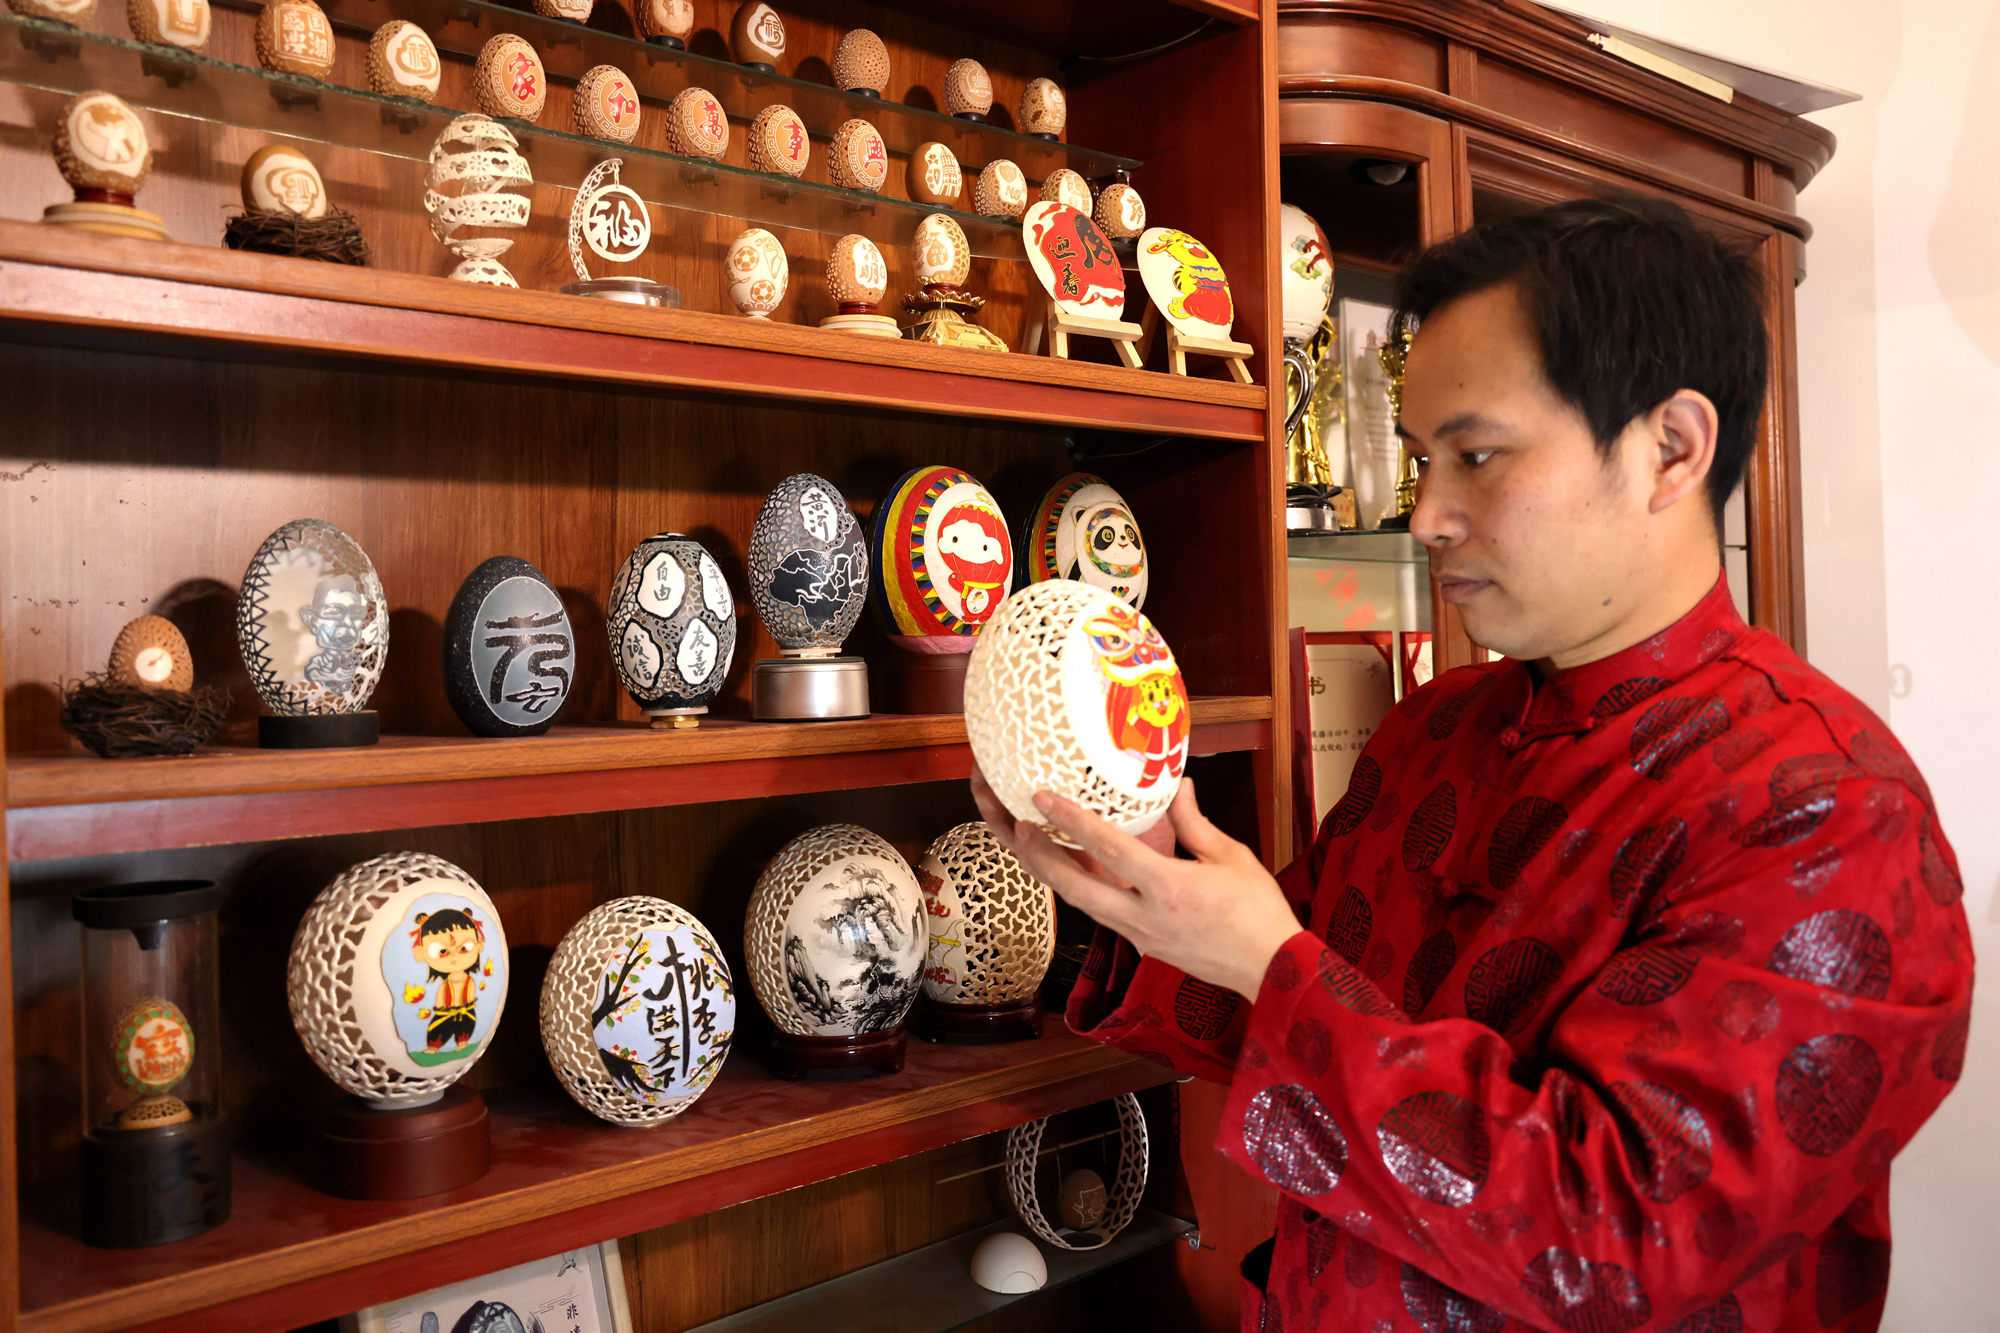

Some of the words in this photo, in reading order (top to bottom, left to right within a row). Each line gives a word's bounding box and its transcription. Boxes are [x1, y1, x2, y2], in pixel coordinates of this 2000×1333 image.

[1047, 235, 1081, 296] 迎春
[653, 560, 673, 602] 自由
[626, 634, 653, 681] 诚信
[687, 625, 711, 678] 友善
